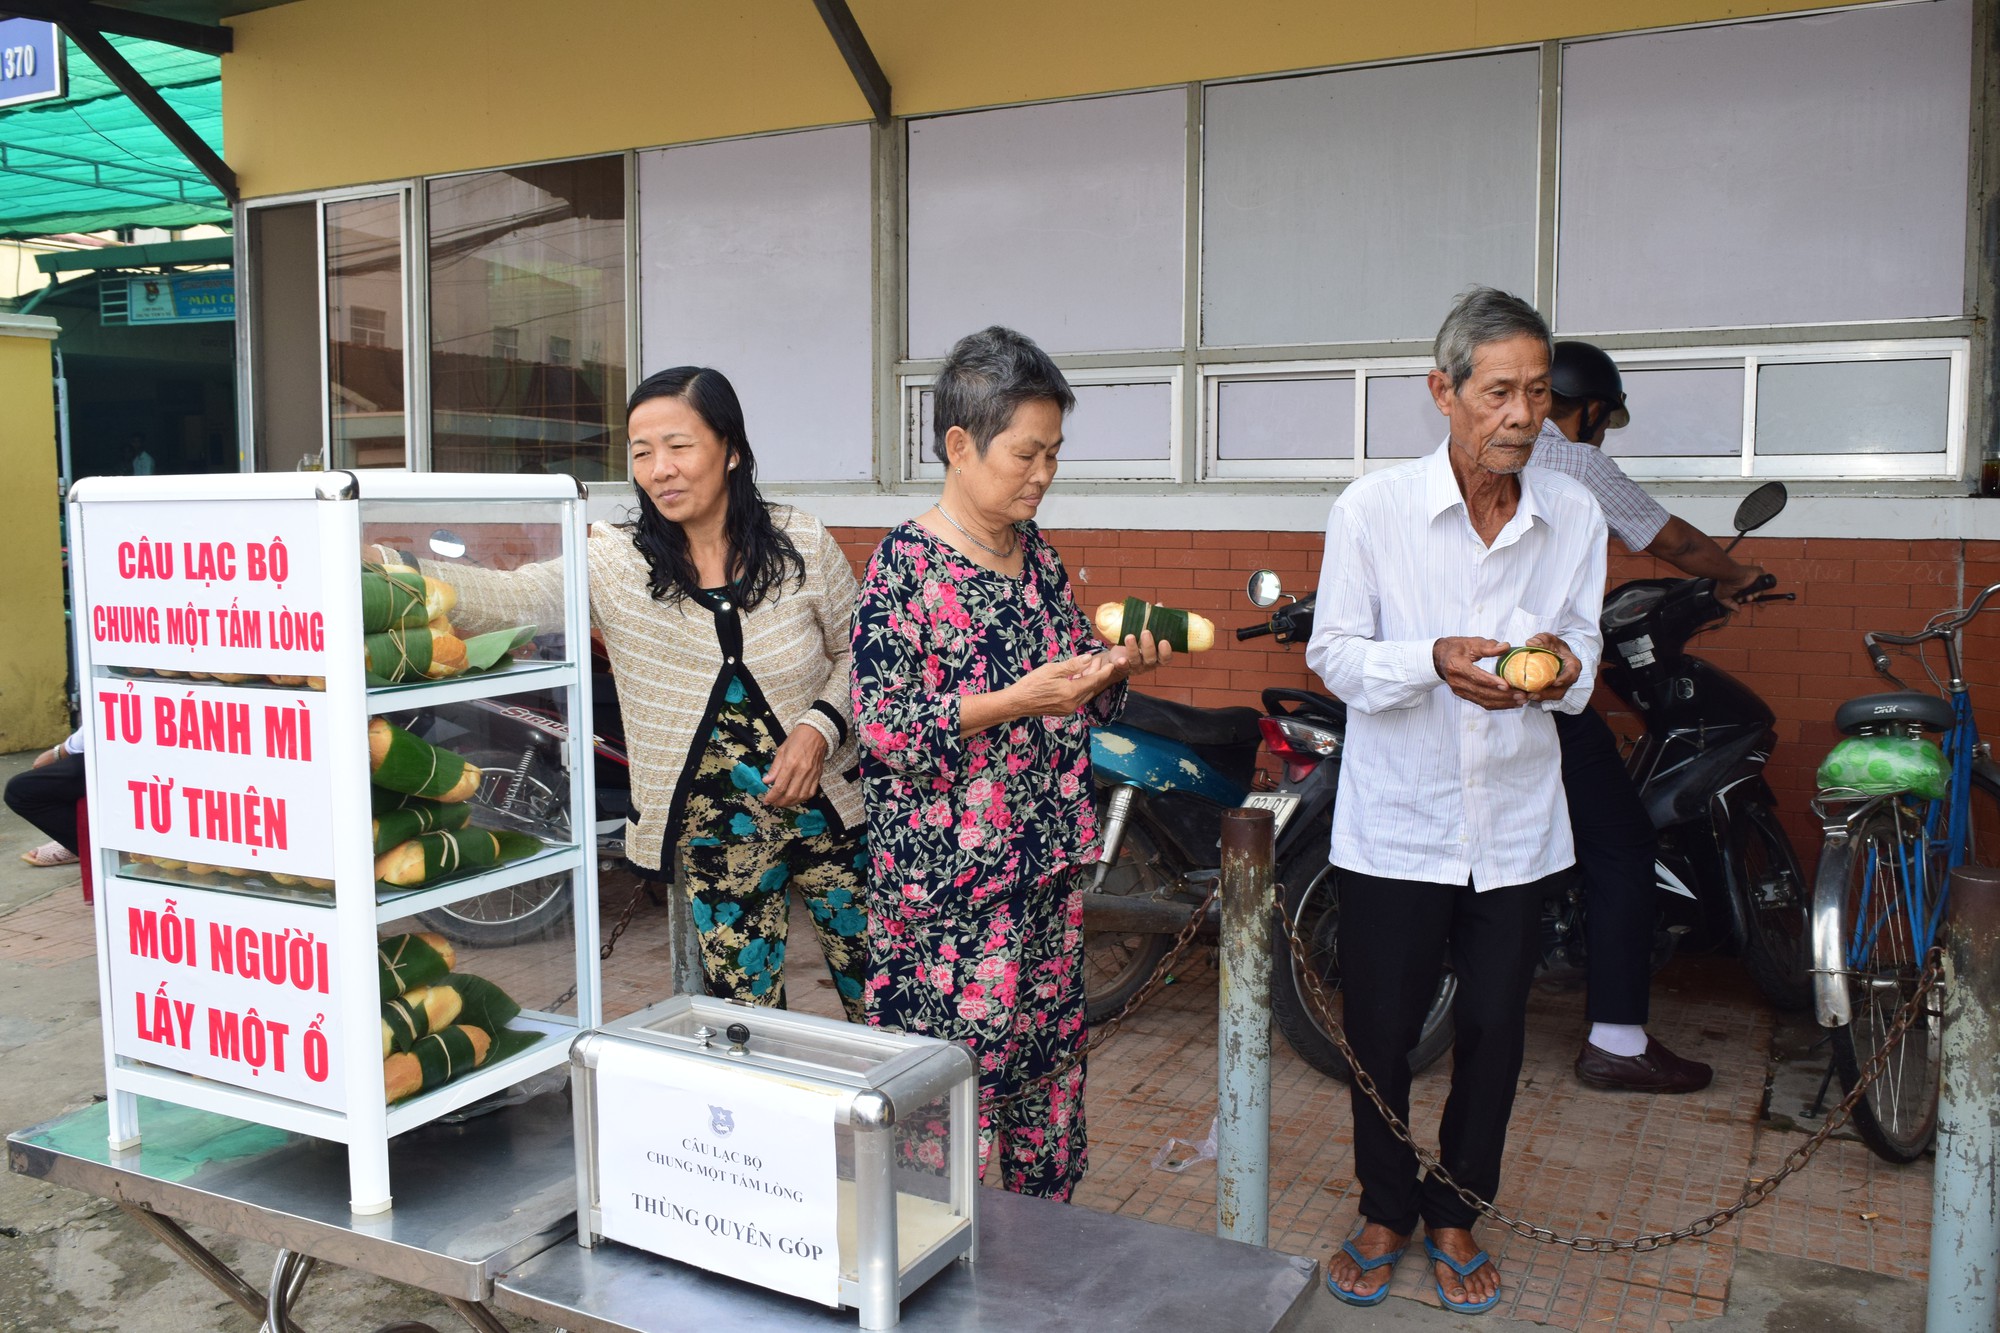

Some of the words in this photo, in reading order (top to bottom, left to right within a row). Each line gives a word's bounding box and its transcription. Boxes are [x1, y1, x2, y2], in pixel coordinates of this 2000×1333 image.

[117, 535, 174, 581] CÂU
[183, 542, 237, 590] LẠC
[246, 535, 289, 590] BỘ
[93, 604, 161, 645] CHUNG
[165, 601, 211, 654] MỘT
[215, 596, 262, 649] TẤM
[268, 602, 325, 653] LÒNG
[98, 681, 143, 745] TỦ
[153, 690, 252, 756] BÁNH
[264, 699, 312, 763] MÌ
[127, 774, 175, 835] TỪ
[182, 785, 288, 858] THIỆN
[127, 898, 197, 968] MỖI
[209, 921, 330, 995] NGƯỜI
[135, 980, 196, 1052] LẤY
[207, 1007, 290, 1077] MỘT
[302, 1012, 329, 1083] Ổ
[646, 1150, 693, 1173] CHUNG
[696, 1163, 727, 1182] MỘT
[764, 1181, 803, 1203] LÒNG
[681, 1137, 709, 1155] CÂU
[713, 1146, 740, 1164] LẠC
[743, 1154, 762, 1171] BỘ
[632, 1192, 700, 1227] THÙNG
[704, 1213, 772, 1250] QUYÊN
[779, 1236, 823, 1261] GÓP
